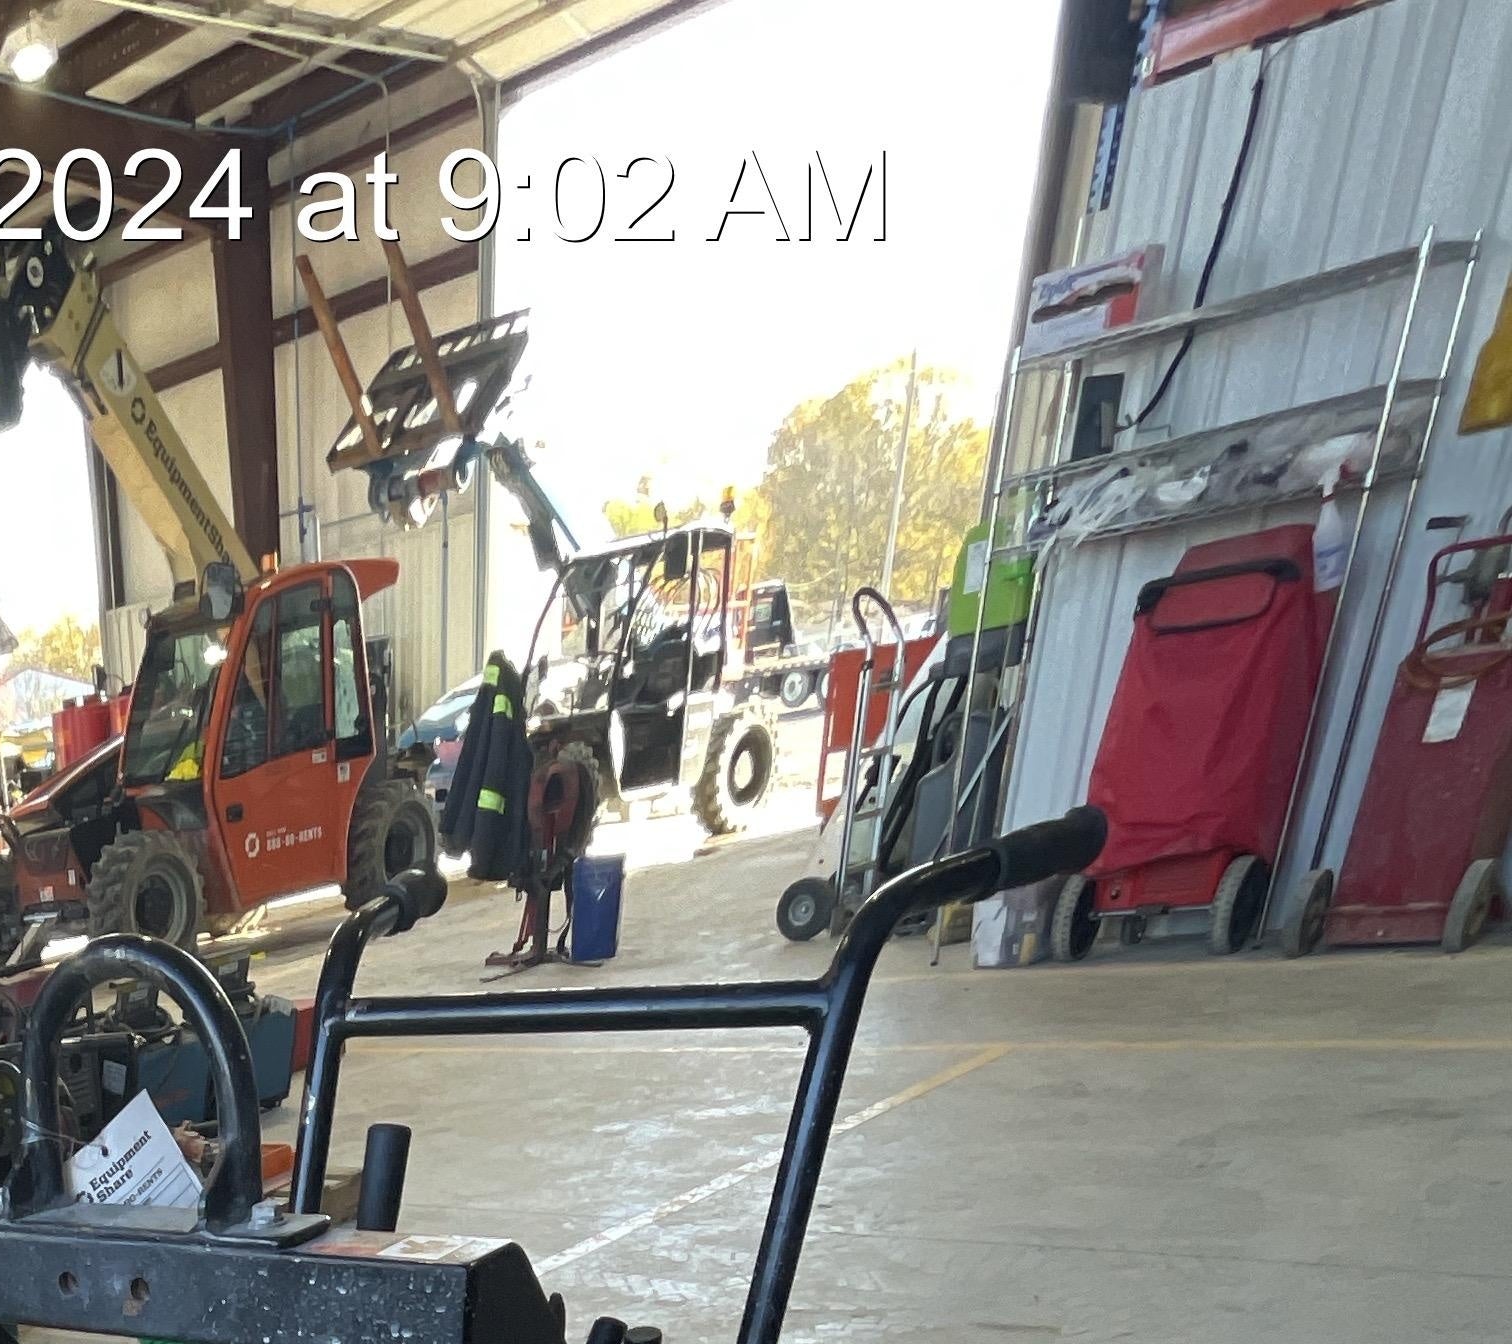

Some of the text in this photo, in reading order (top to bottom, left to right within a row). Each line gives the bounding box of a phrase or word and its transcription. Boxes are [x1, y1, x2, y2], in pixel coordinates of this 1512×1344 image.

[145, 419, 230, 564] EquipmentSha
[88, 1129, 152, 1191] Equipment
[96, 1168, 134, 1203] Share
